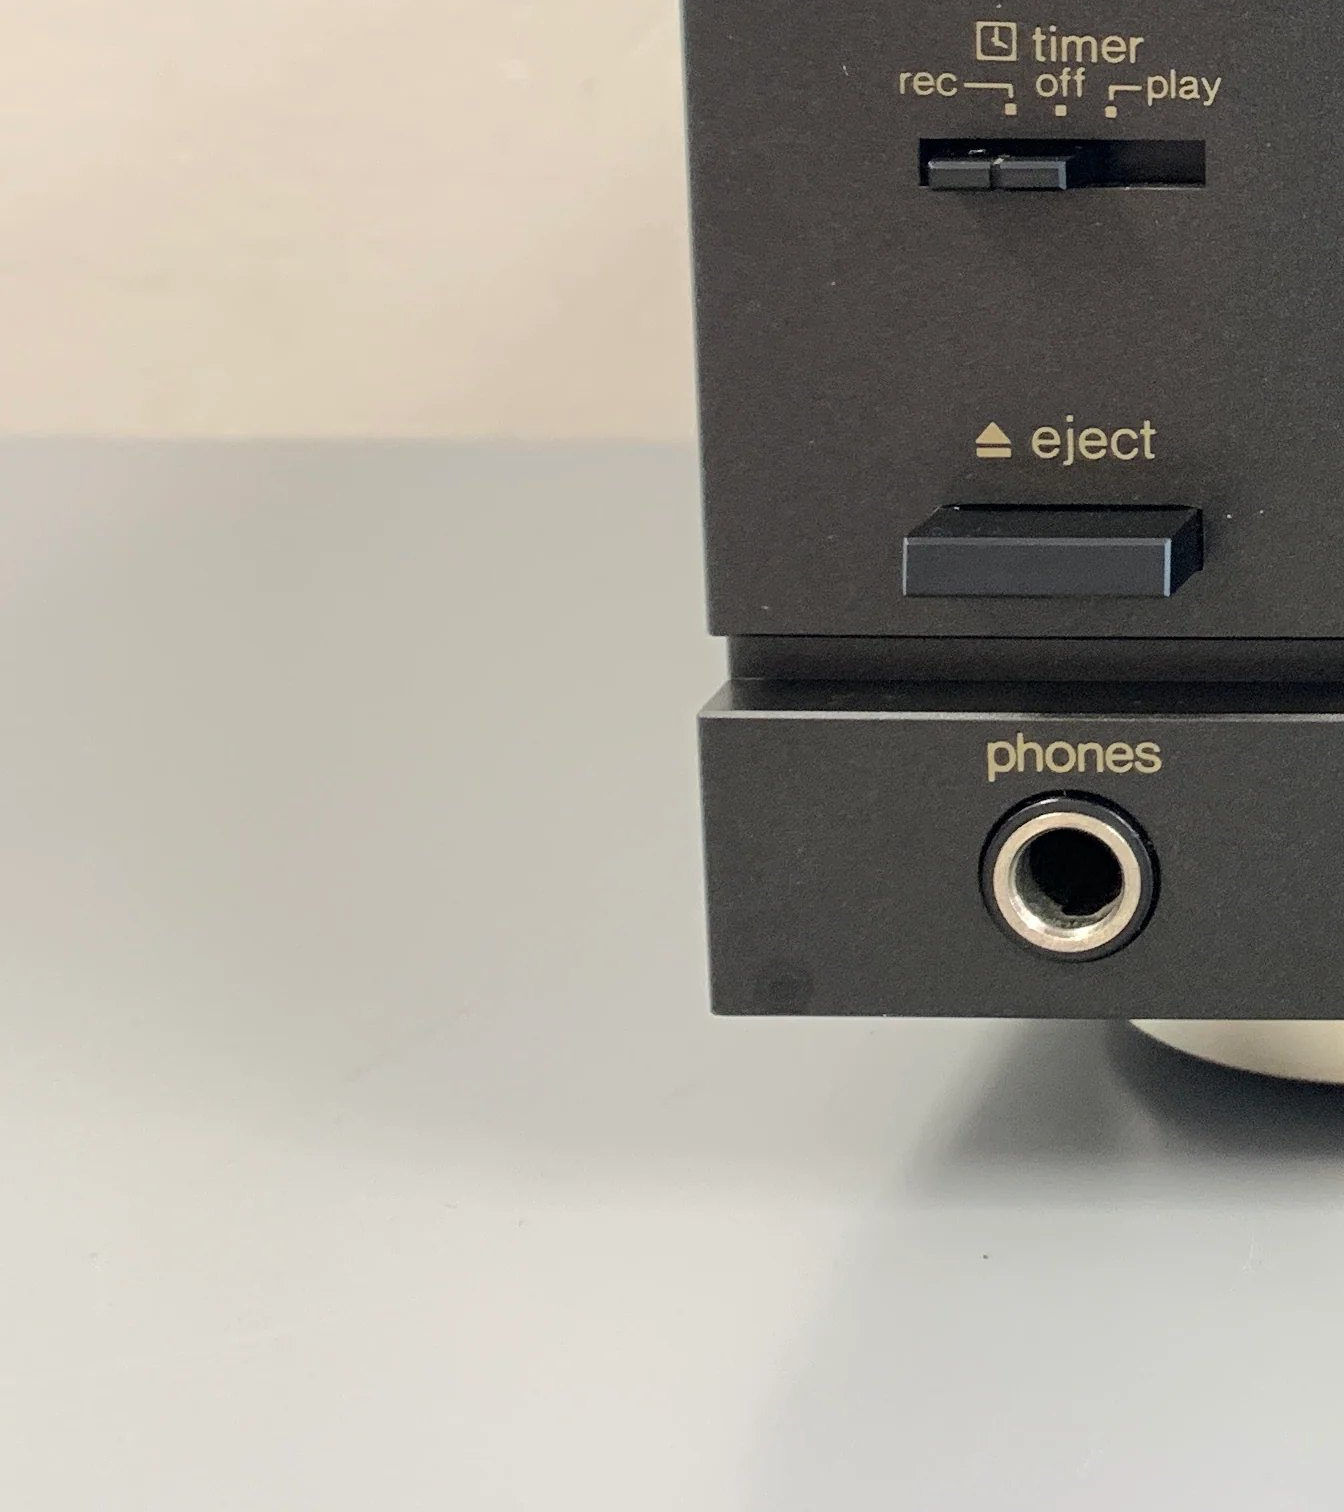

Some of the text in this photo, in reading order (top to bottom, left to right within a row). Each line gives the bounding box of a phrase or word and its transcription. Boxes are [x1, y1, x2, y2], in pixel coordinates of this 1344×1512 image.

[1032, 25, 1144, 63] timer
[900, 67, 1221, 106] rec off play
[1032, 415, 1156, 466] eject
[987, 732, 1162, 782] phones
